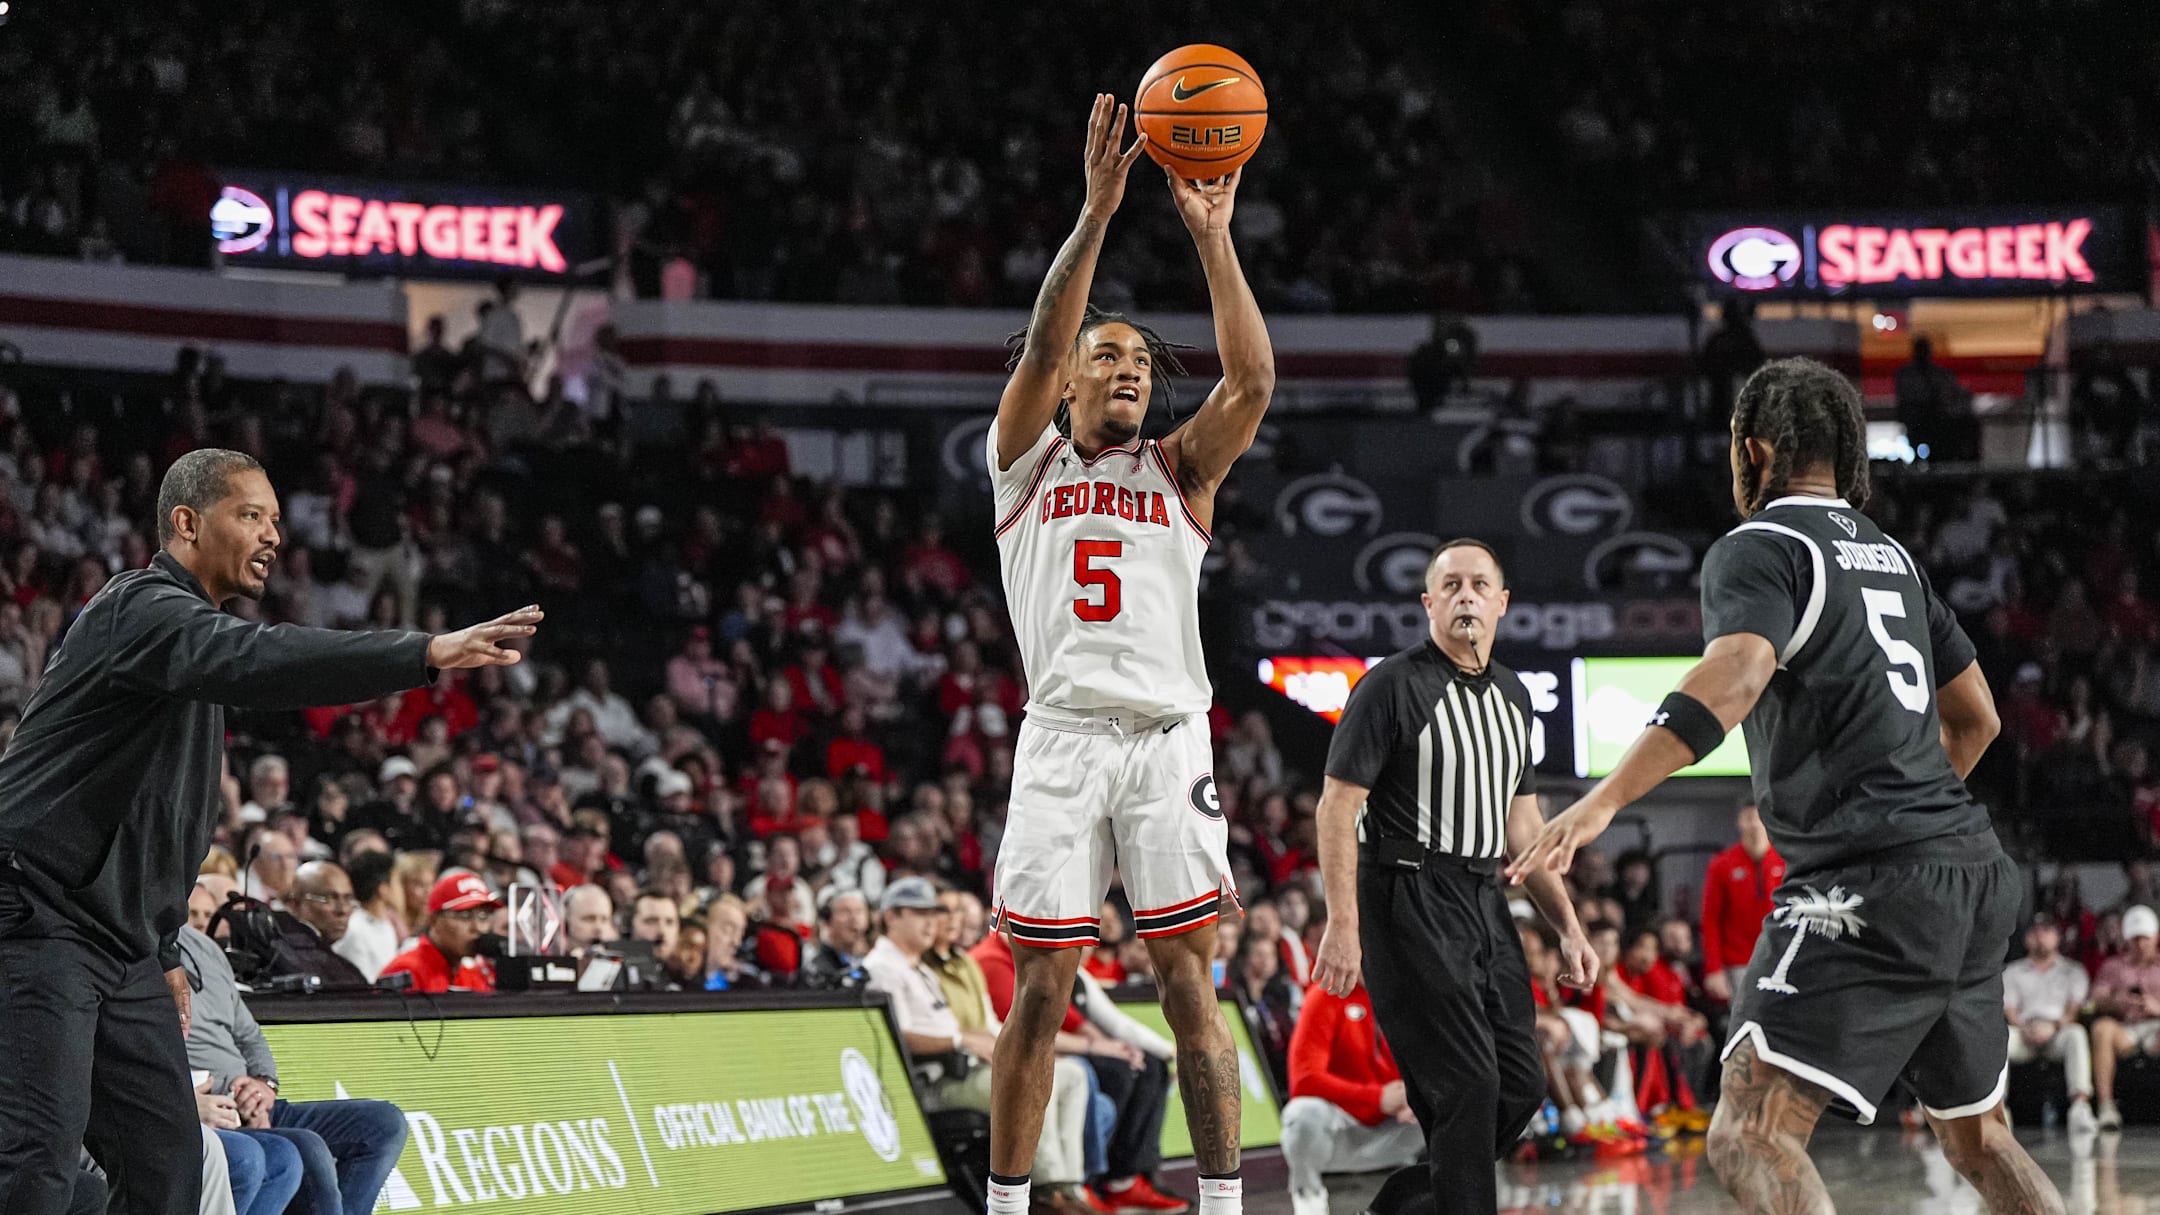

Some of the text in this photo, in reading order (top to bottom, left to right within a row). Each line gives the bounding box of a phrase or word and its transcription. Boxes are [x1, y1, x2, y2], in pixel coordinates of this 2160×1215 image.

[1171, 124, 1242, 145] ELITE
[292, 190, 568, 273] SEATGEEK
[1818, 218, 2095, 285] SEATGEEK
[1041, 481, 1170, 527] GEORGIA
[1073, 539, 1122, 622] 5
[1831, 539, 1908, 575] JOHNSON
[1861, 587, 1930, 714] 5
[654, 1092, 856, 1150] OFFICIAL BANK OF THE
